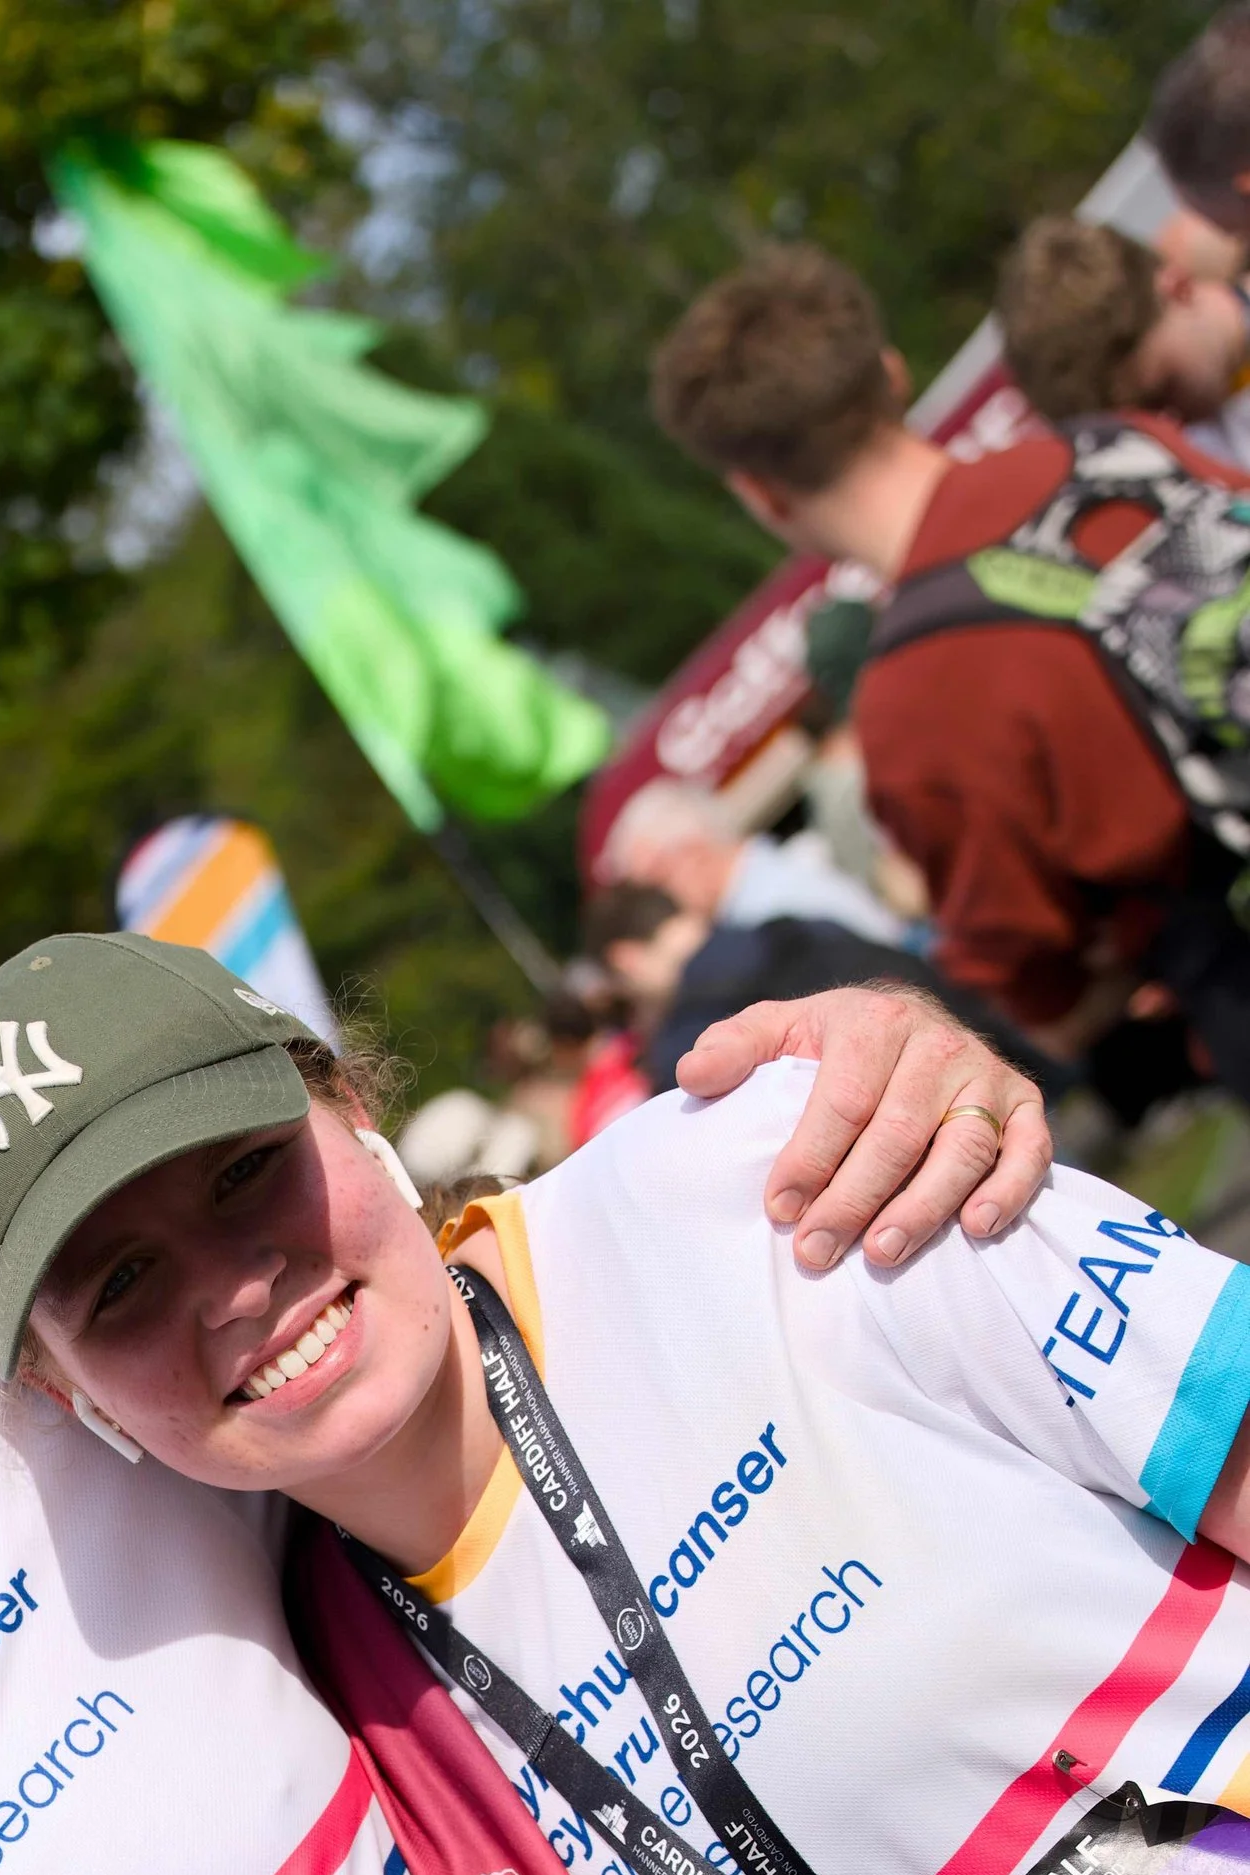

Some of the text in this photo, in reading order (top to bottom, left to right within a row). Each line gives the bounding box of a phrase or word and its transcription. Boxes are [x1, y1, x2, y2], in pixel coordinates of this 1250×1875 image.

[480, 1349, 568, 1512] CARDIFF HALF
[498, 1335, 584, 1497] HANNER MARATHON CAERDYDD
[649, 1421, 788, 1618] canser
[381, 1576, 429, 1632] 2026
[712, 1560, 884, 1765] esearch
[548, 1715, 660, 1866] cyru
[662, 1693, 710, 1768] 2026
[741, 1807, 786, 1863] CAERDYDD
